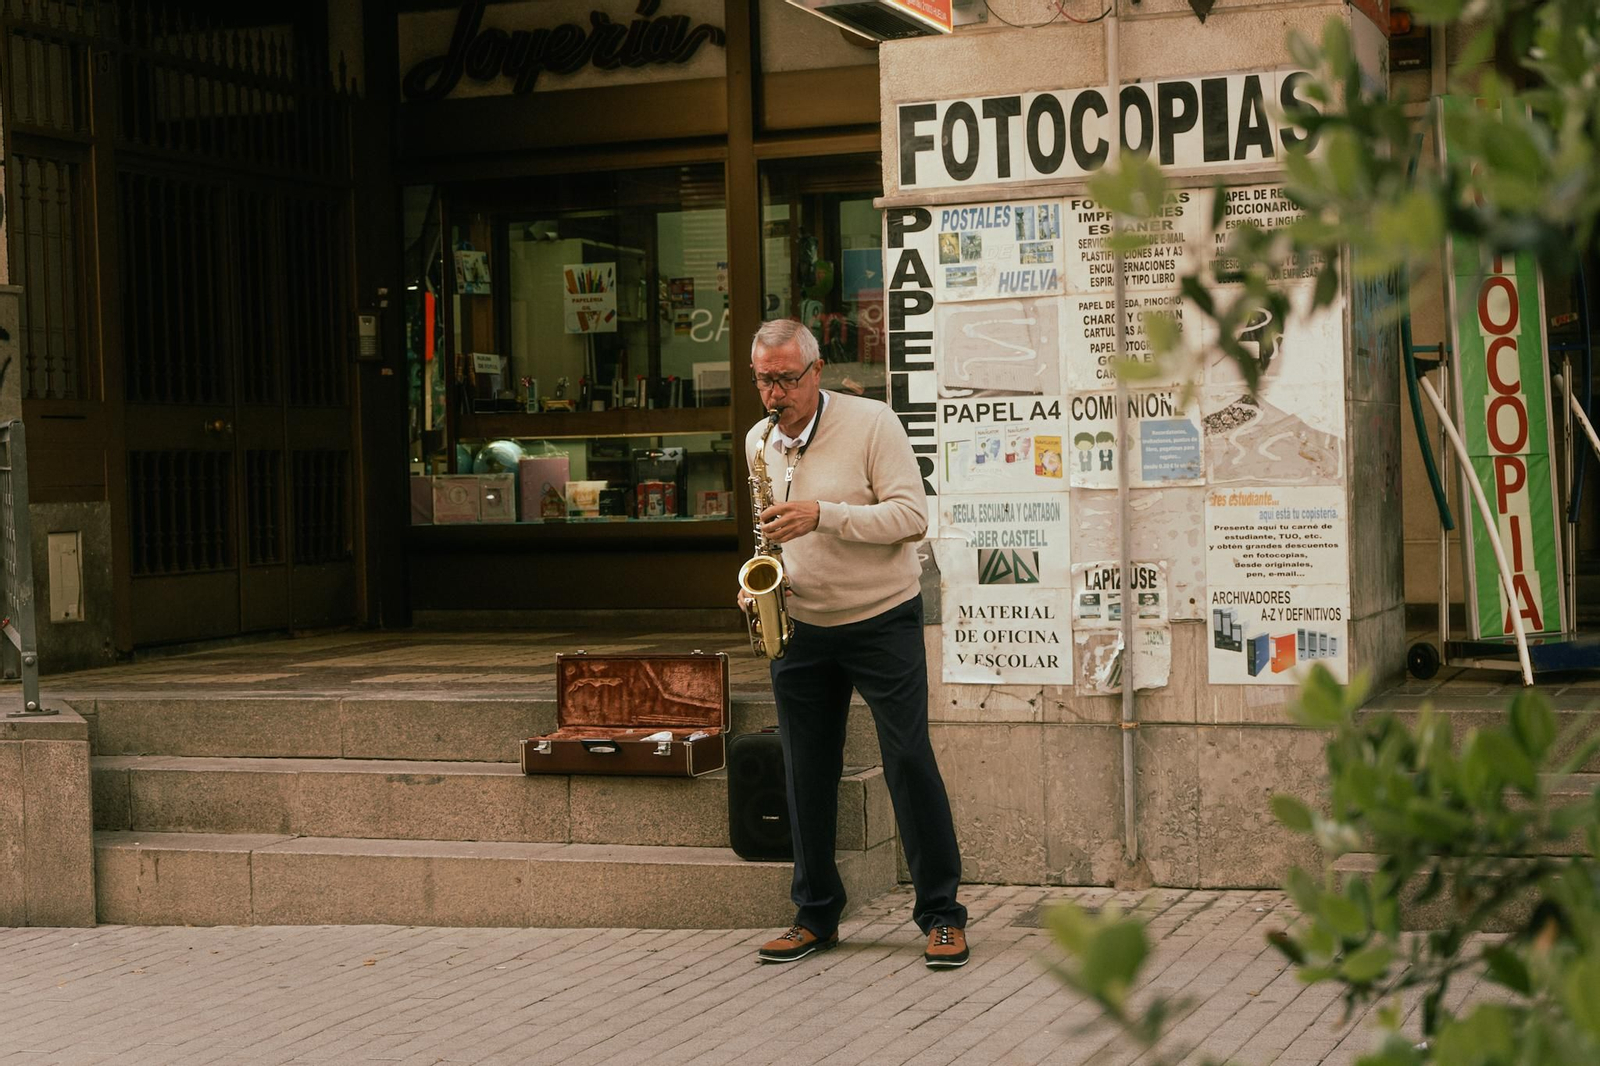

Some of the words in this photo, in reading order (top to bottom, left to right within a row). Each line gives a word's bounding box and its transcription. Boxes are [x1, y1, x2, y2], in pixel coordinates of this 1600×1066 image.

[899, 71, 1322, 186] FOTOCOPIAS
[1221, 190, 1251, 203] APEL
[1253, 189, 1267, 200] DE
[941, 205, 1012, 232] POSTALES
[1088, 220, 1174, 236] ESANER
[1160, 232, 1185, 245] E-MAIL
[1081, 247, 1152, 262] PLASTIFICIONES
[1154, 247, 1164, 257] A4
[1166, 247, 1171, 257] Y
[1173, 246, 1183, 256] A3
[1089, 259, 1175, 275] ENCUERNACIONES
[999, 268, 1058, 293] HUELVA
[1131, 274, 1150, 285] TIPO
[1152, 272, 1175, 284] LIBRO
[1078, 300, 1103, 311] PAPEL
[1105, 300, 1115, 310] DE
[1121, 299, 1141, 309] EDA,
[1144, 297, 1184, 306] PINOCHO,
[1083, 313, 1116, 325] CHAR
[1127, 312, 1133, 323] Y
[1137, 309, 1183, 322] COFAN
[1084, 326, 1135, 338] CARTULAS
[1090, 342, 1115, 354] PAPEL
[1474, 98, 1544, 634] OCOPIA
[943, 402, 1023, 424] PAPEL
[1029, 400, 1062, 421] A4
[979, 502, 1015, 523] ESCUADRA
[1016, 502, 1022, 522] Y
[1023, 498, 1061, 522] CARTABÓN
[1257, 524, 1277, 532] aquí
[965, 530, 999, 548] ABER
[1001, 529, 1048, 547] CASTELL
[1278, 533, 1302, 541] TUO,
[1217, 542, 1243, 550] obtén
[1245, 543, 1282, 551] grandes
[1256, 552, 1308, 560] fotocopias,
[1234, 561, 1262, 569] desde
[1264, 561, 1313, 569] originales,
[1130, 567, 1157, 590] USB
[1268, 570, 1305, 578] e-mail...
[1212, 590, 1291, 605] ARCHIVADORES
[958, 605, 1055, 619] MATERIAL
[1261, 608, 1276, 621] A-Z
[1278, 608, 1284, 621] Y
[1286, 607, 1342, 621] DEFINITIVOS
[955, 629, 978, 643] DE
[983, 629, 1060, 644] OFICINA
[974, 653, 1059, 668] ESCOLAR
